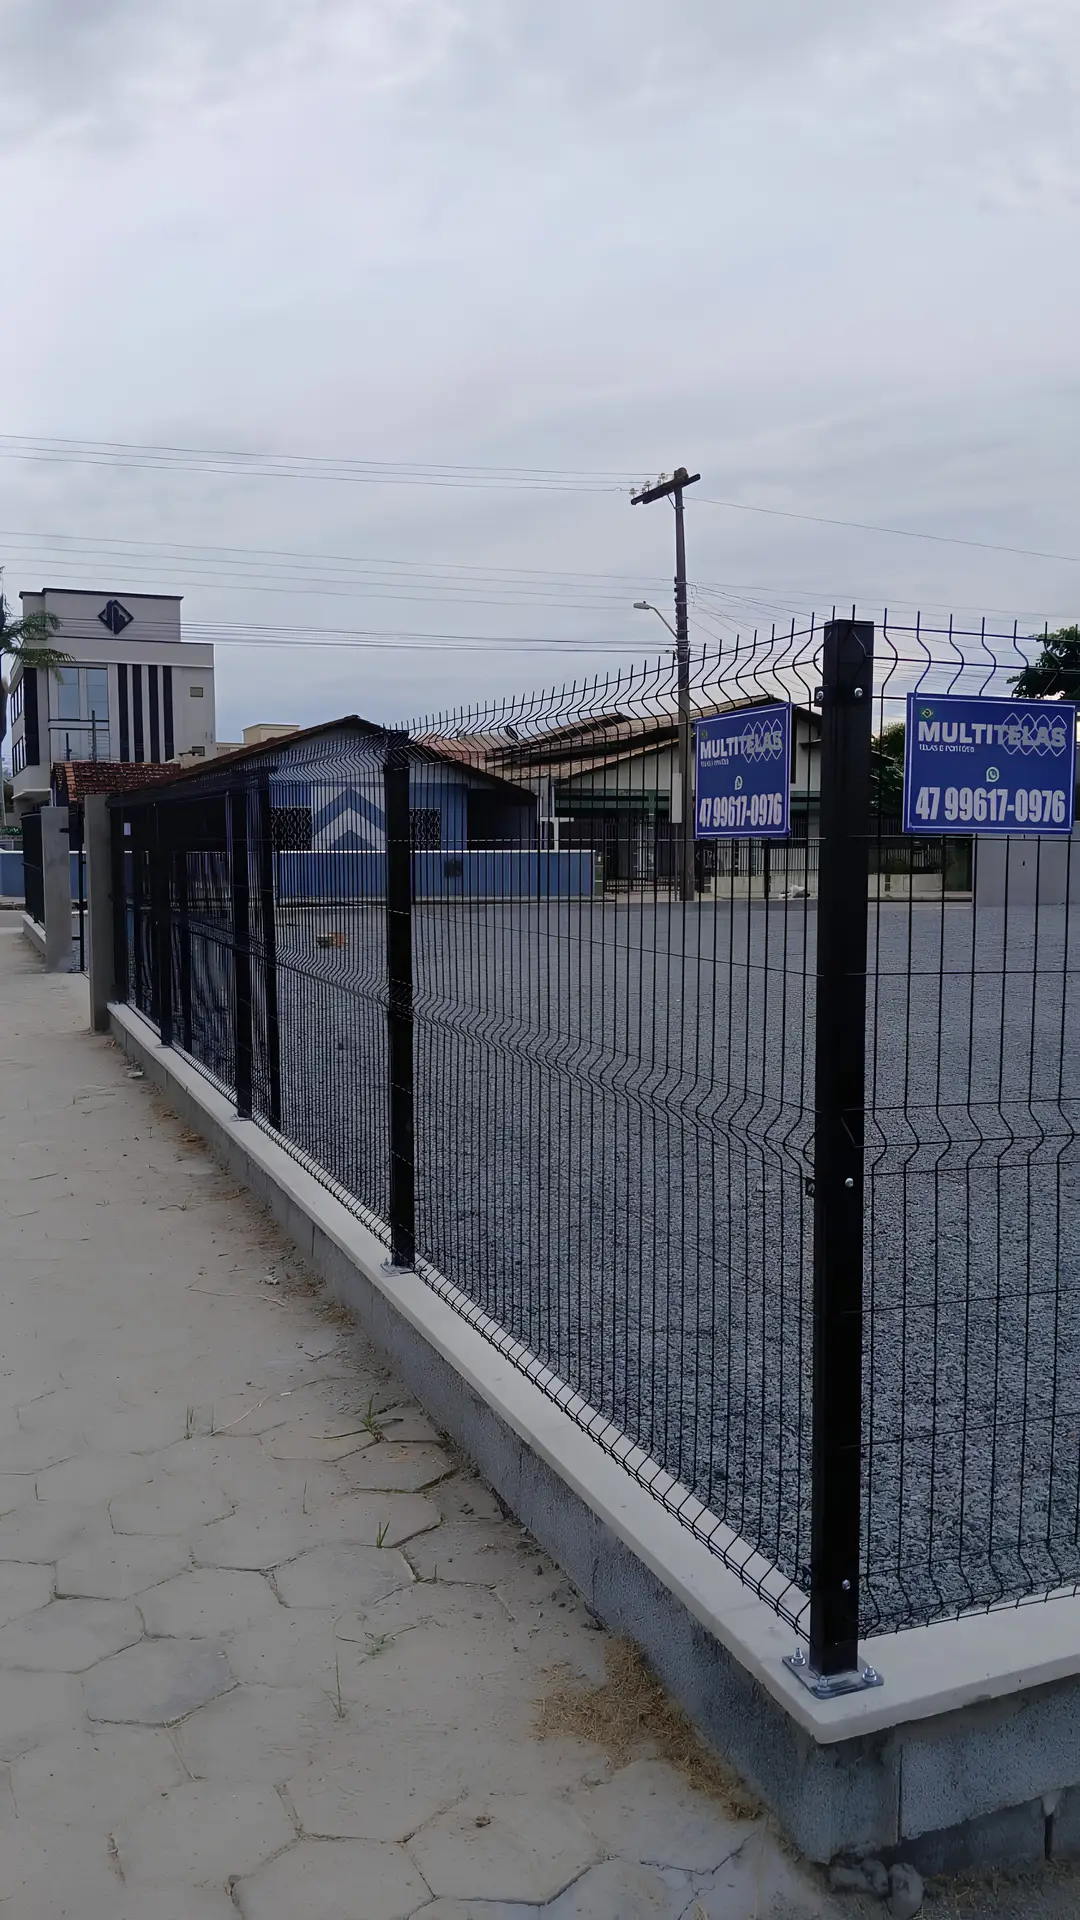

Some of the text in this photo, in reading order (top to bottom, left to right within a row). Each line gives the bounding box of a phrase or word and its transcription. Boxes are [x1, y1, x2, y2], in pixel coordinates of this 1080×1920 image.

[701, 731, 783, 759] MULTITELAS
[918, 721, 1066, 747] MULTITELAS
[699, 793, 783, 827] 47 99617-0976
[915, 786, 1066, 823] 47 99617-0976
